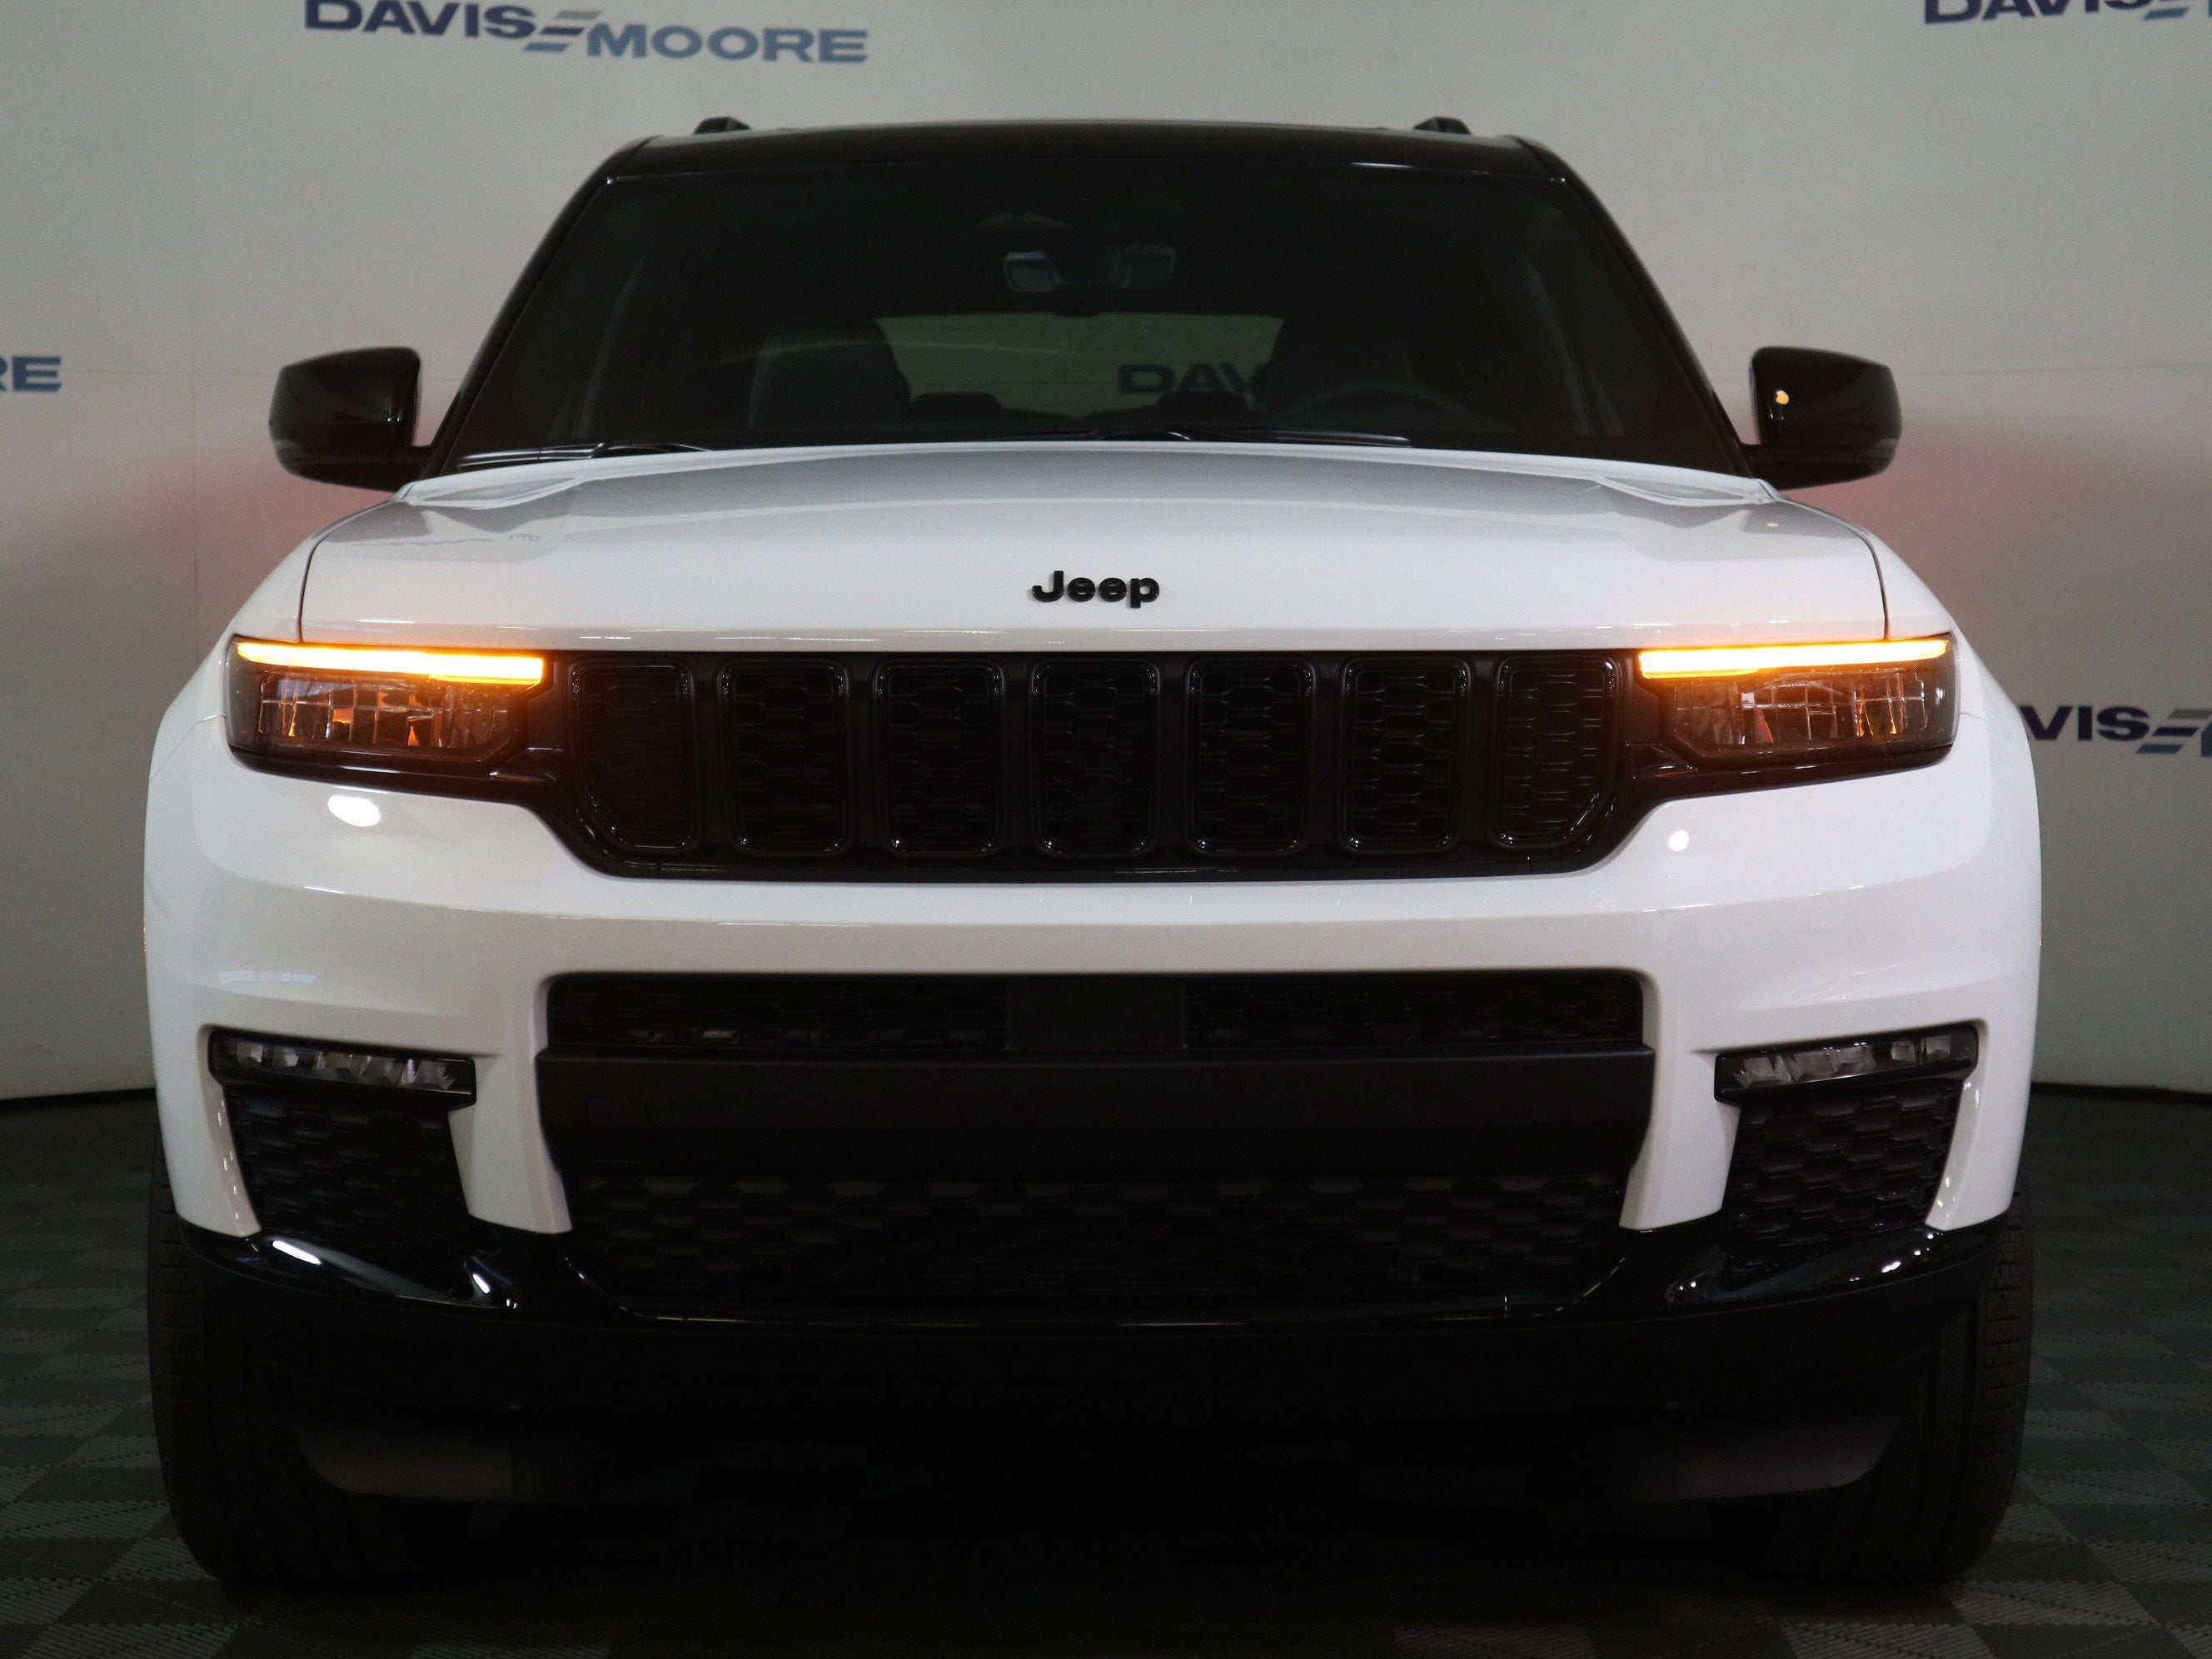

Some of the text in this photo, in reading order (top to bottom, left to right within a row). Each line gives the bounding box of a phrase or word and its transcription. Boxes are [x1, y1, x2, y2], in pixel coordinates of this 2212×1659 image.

[304, 0, 869, 62] DAVIS MOORE
[1032, 570, 1160, 609] Jeep
